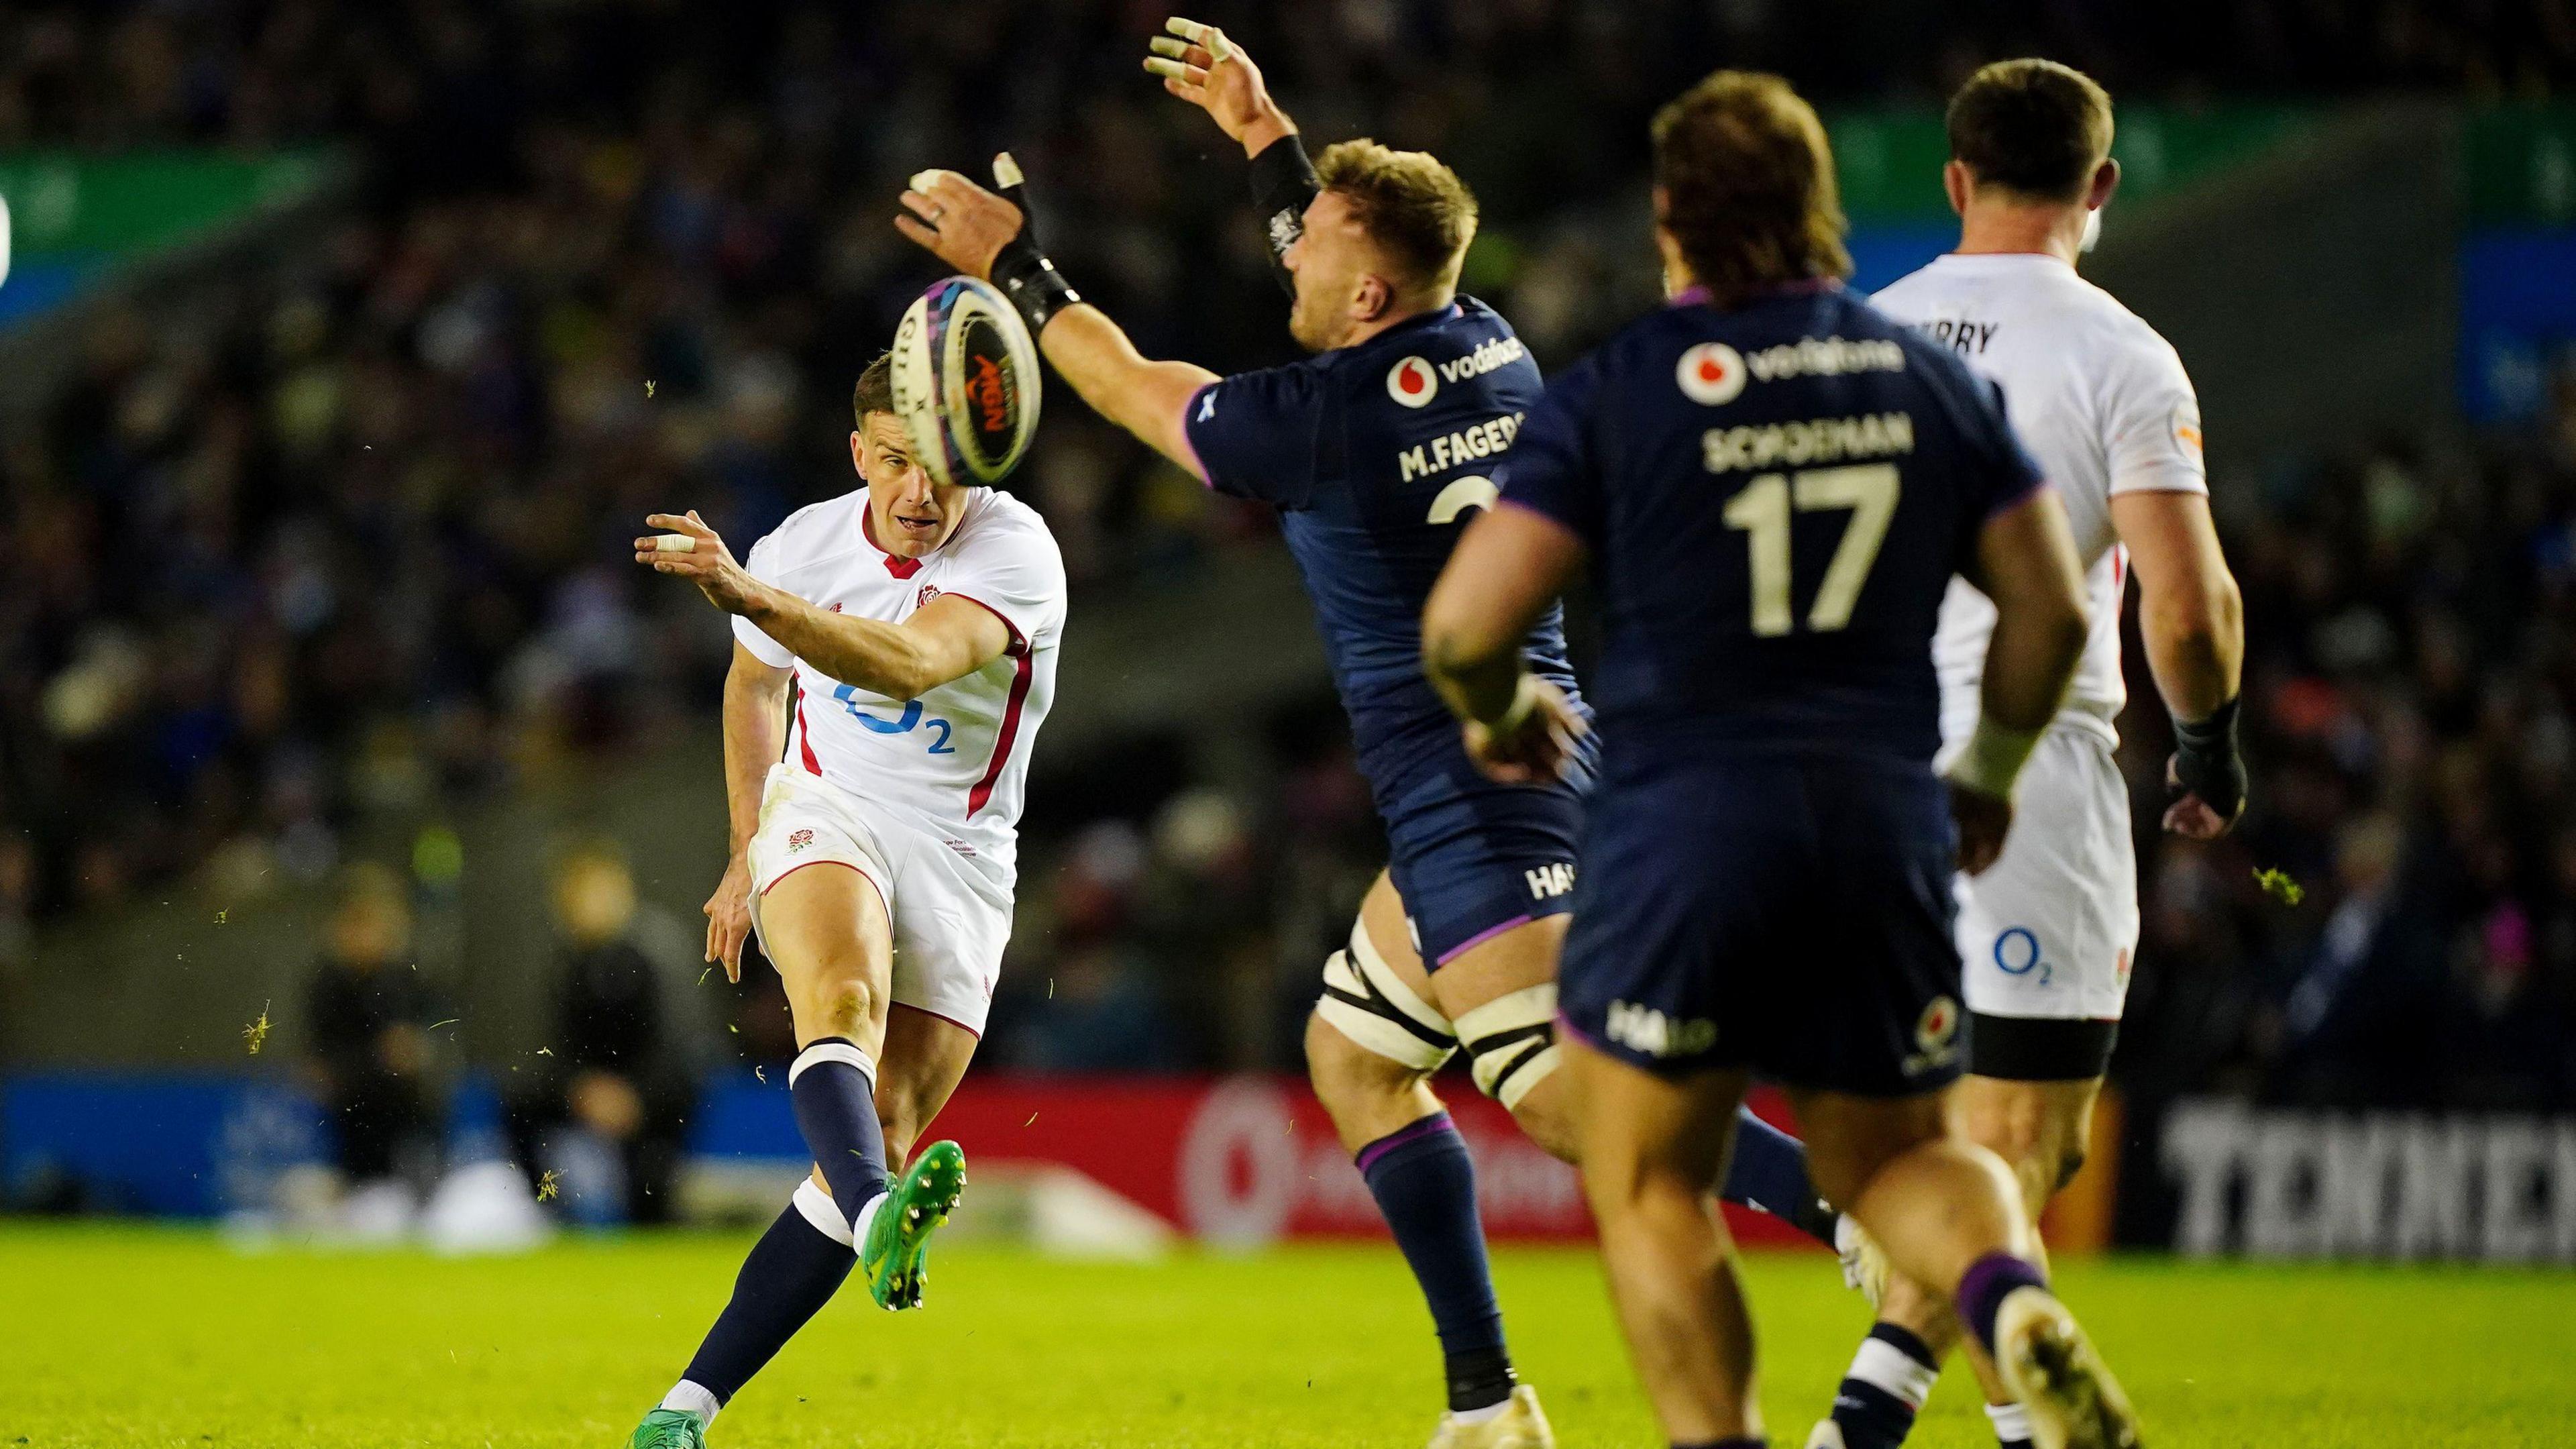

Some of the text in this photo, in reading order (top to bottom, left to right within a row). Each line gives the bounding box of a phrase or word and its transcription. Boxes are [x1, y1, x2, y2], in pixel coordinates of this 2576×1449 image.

[1923, 320, 1998, 353] RRY
[1399, 411, 1526, 483] M.FAGER
[1721, 463, 1902, 637] 17
